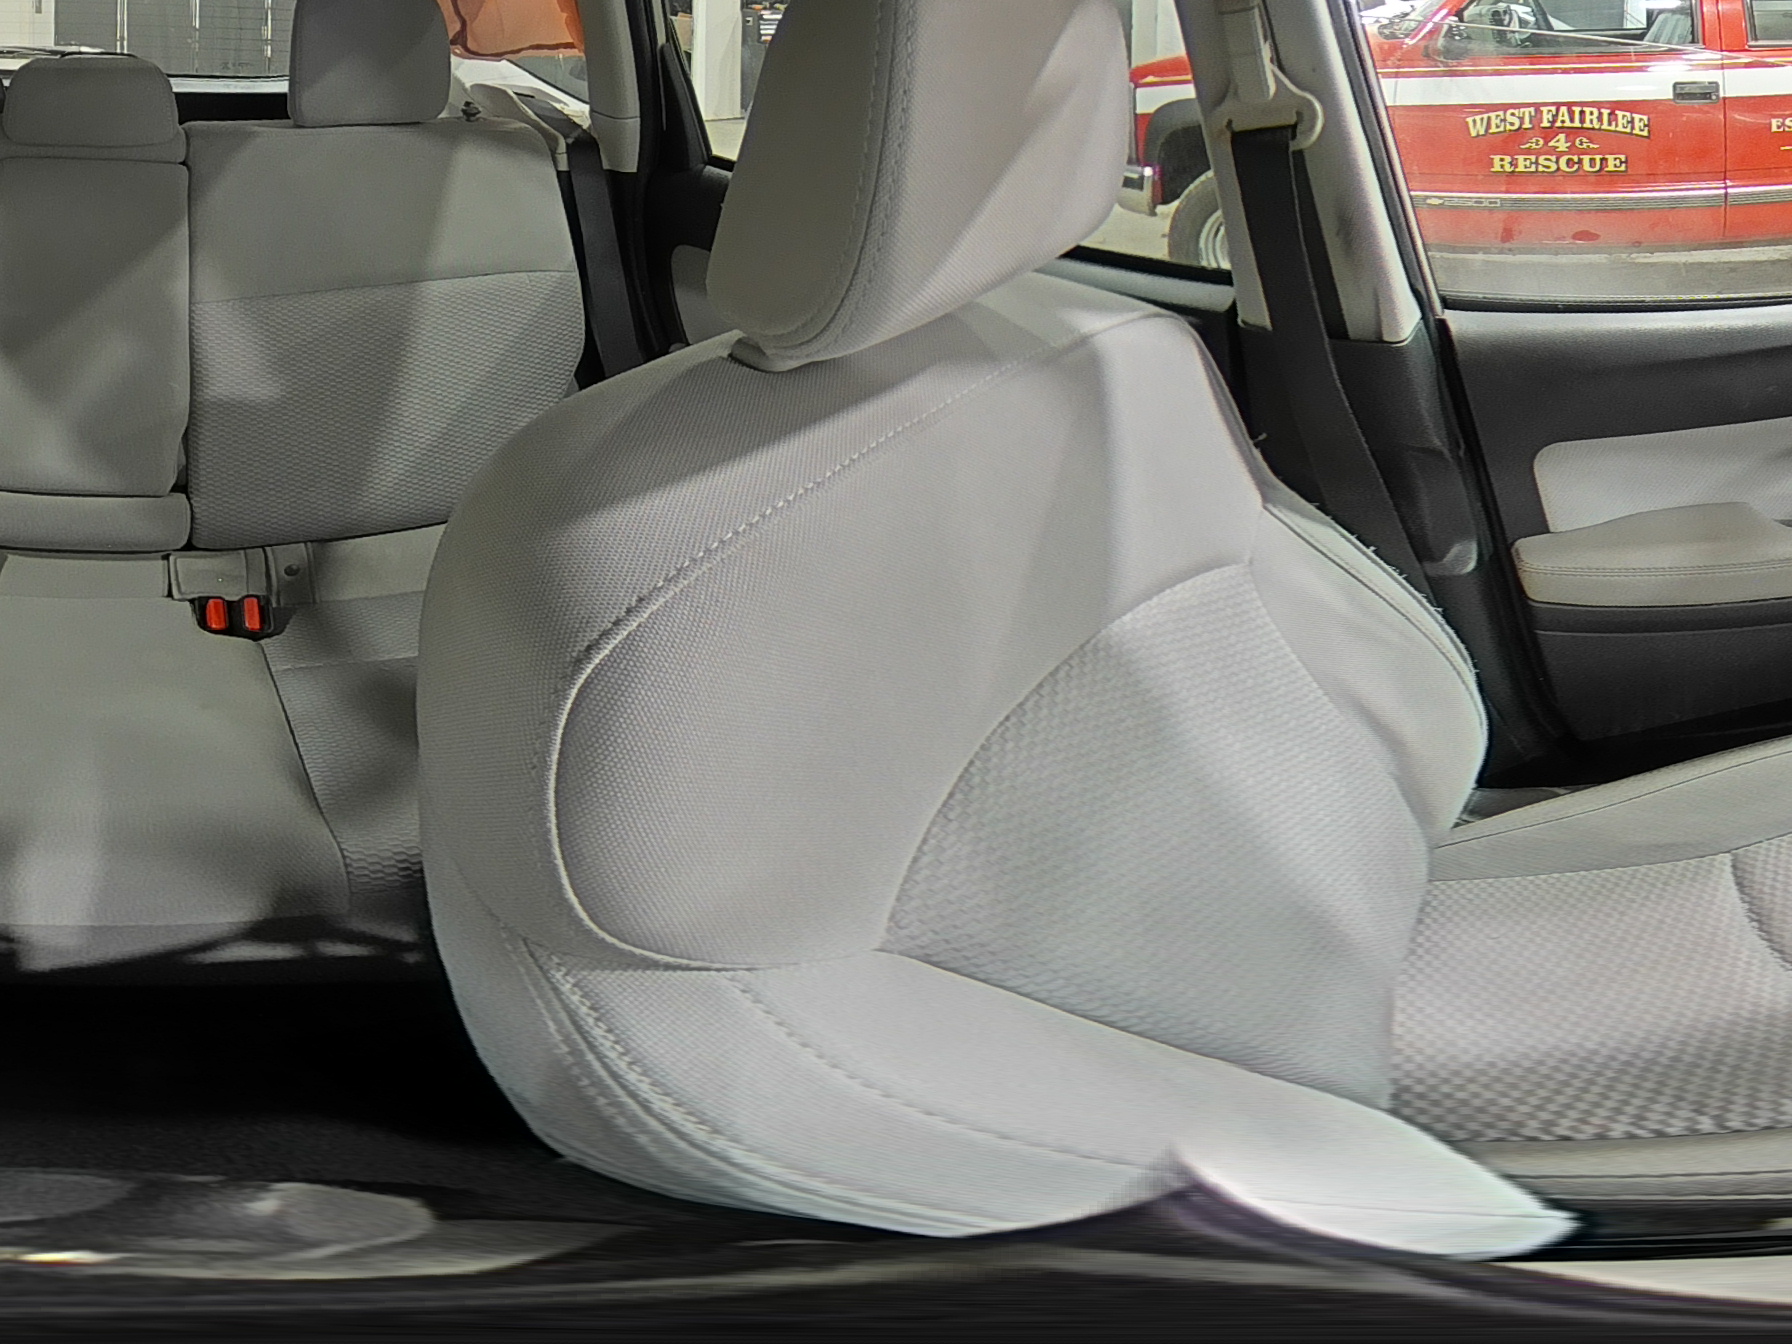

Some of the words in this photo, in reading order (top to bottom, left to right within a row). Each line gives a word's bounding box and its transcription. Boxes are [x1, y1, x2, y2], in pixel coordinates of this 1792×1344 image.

[1466, 107, 1535, 137] WEST
[1539, 106, 1650, 137] FAIRLEE
[1547, 133, 1571, 152] 4
[1489, 154, 1628, 173] RESCUE
